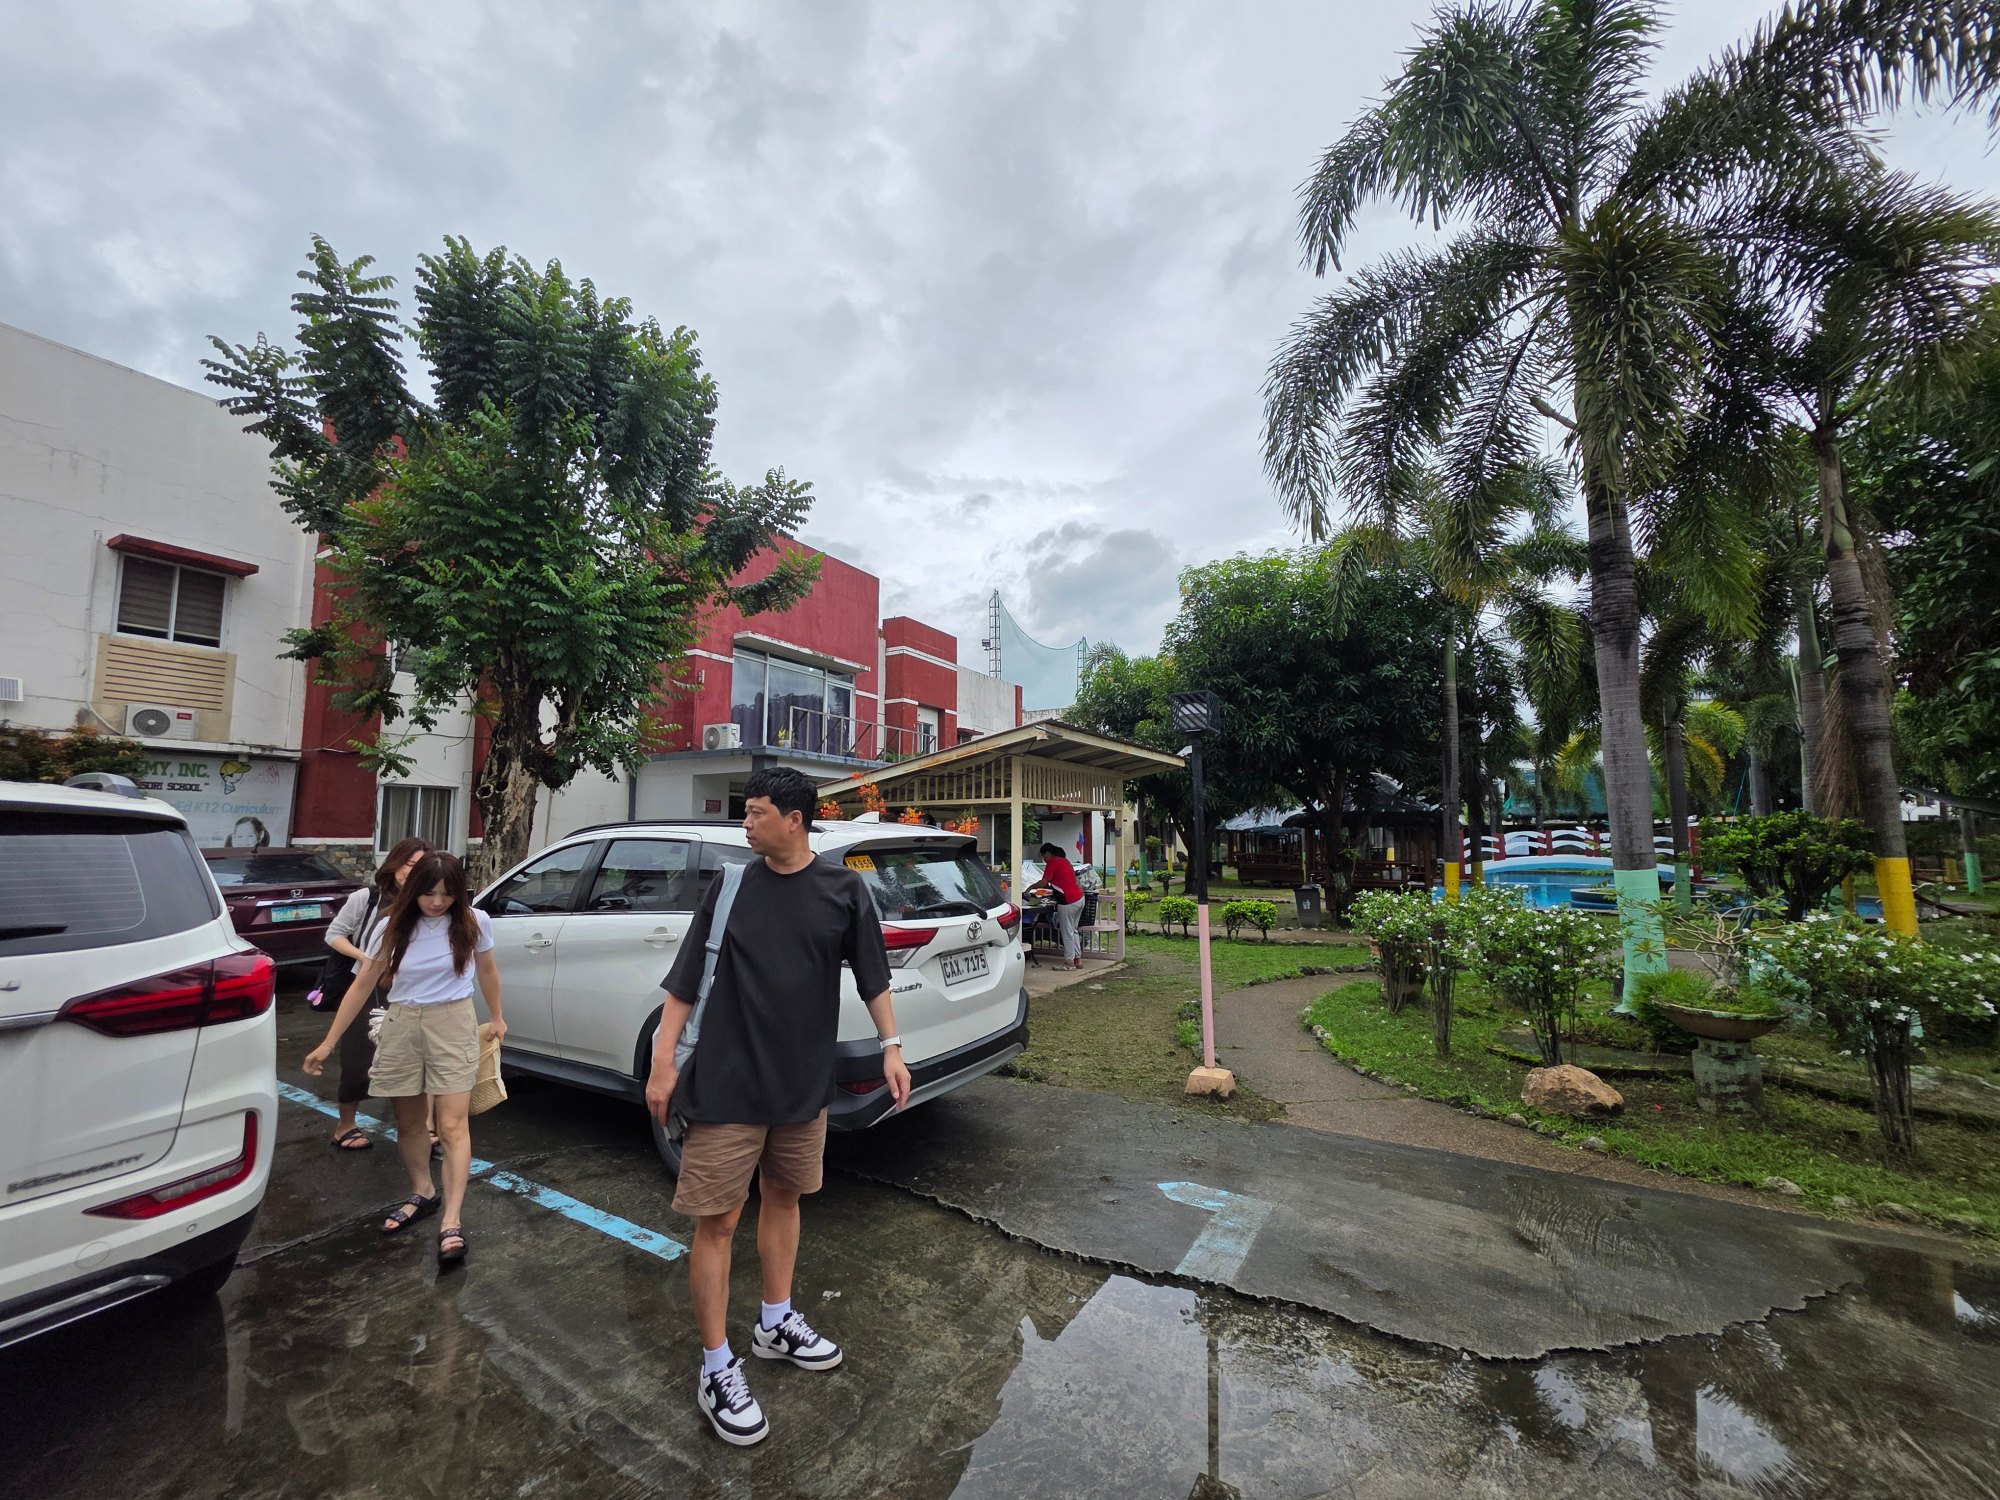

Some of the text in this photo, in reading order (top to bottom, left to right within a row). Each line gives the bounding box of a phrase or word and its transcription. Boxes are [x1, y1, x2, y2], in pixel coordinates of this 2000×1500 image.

[178, 762, 210, 778] INC.
[194, 802, 220, 814] K12
[943, 953, 987, 979] CAX 7175
